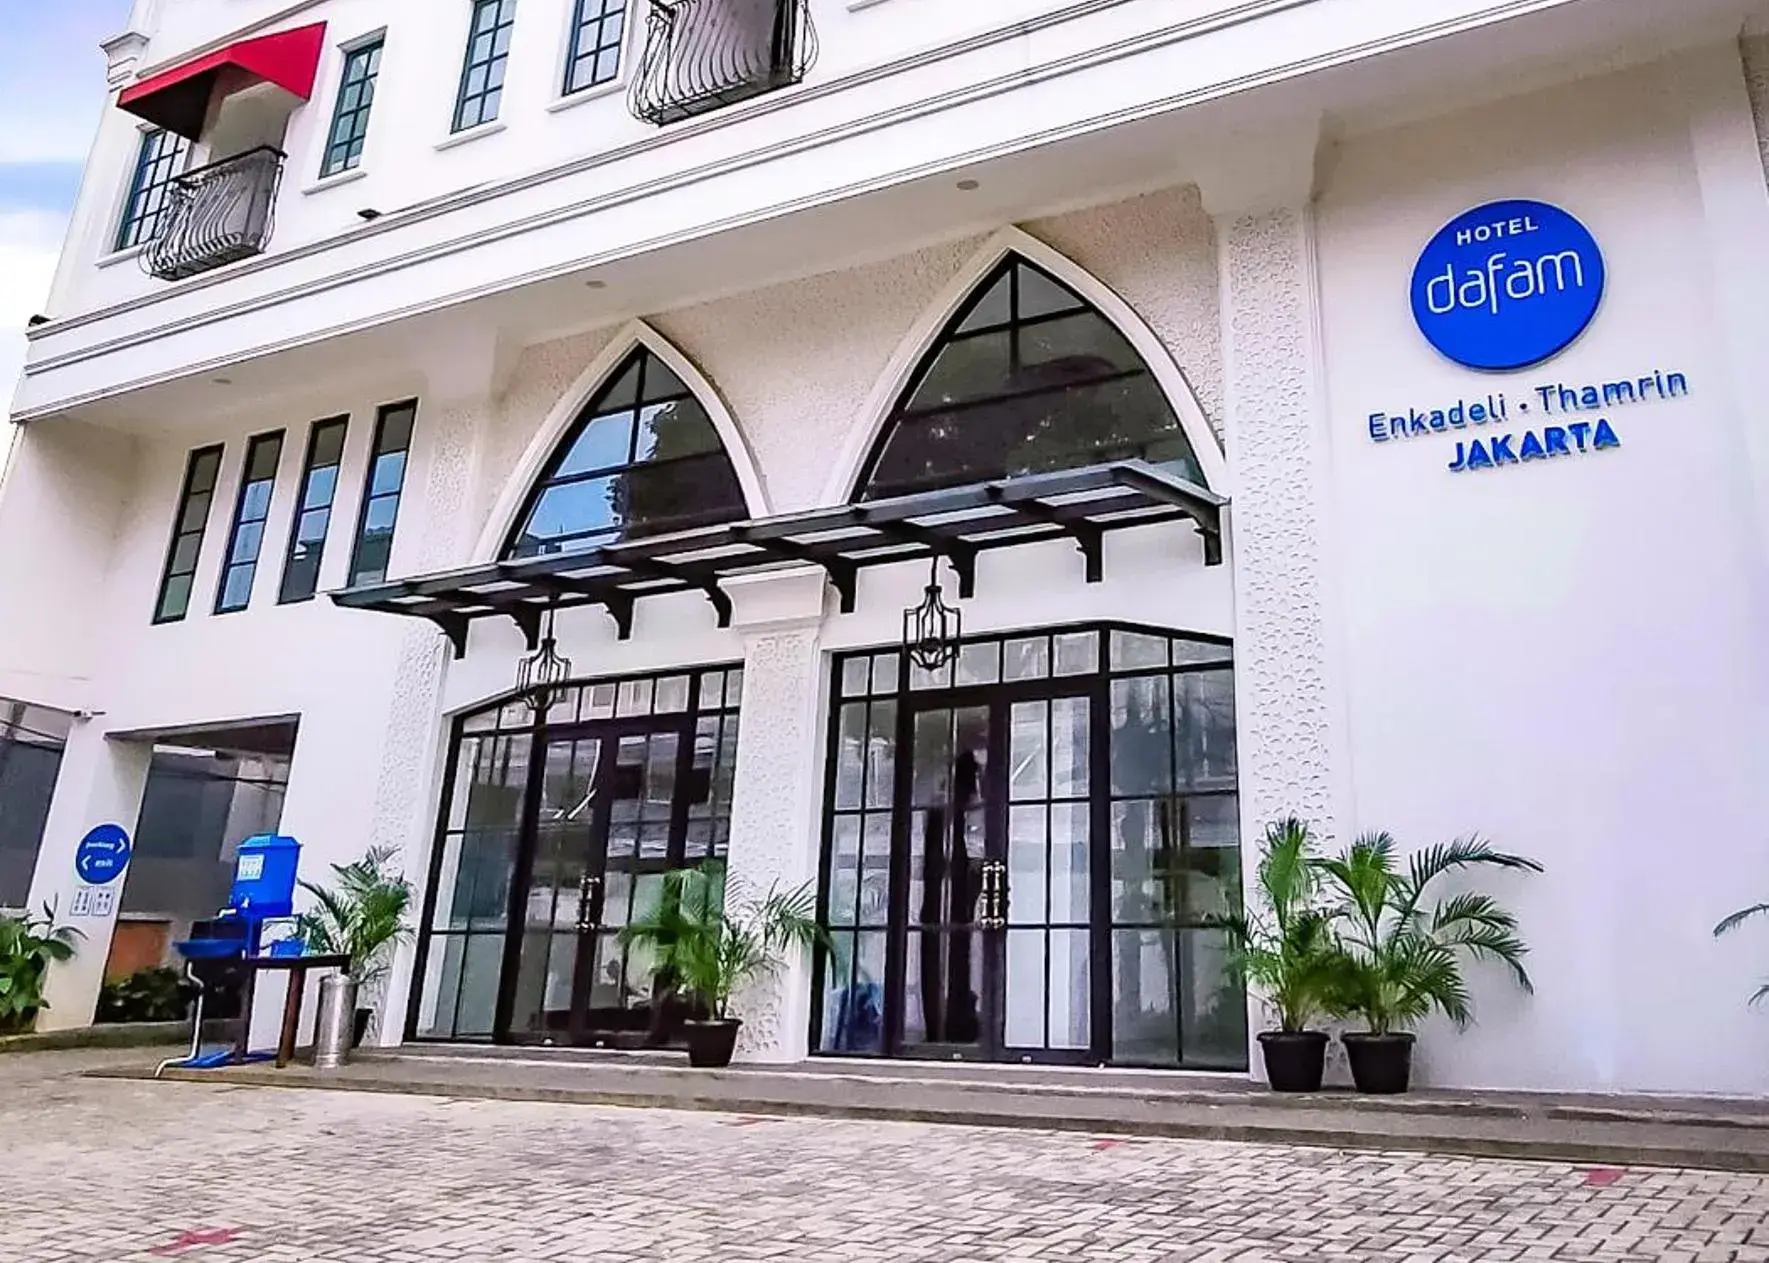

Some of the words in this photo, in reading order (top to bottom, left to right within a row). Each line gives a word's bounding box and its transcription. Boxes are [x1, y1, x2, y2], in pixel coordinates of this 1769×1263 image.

[1456, 216, 1539, 246] HOTEL
[1426, 249, 1584, 315] dafam
[1367, 392, 1507, 441] Enkadeli
[1534, 369, 1689, 414] Thamrin
[1447, 417, 1621, 473] JAKARTA
